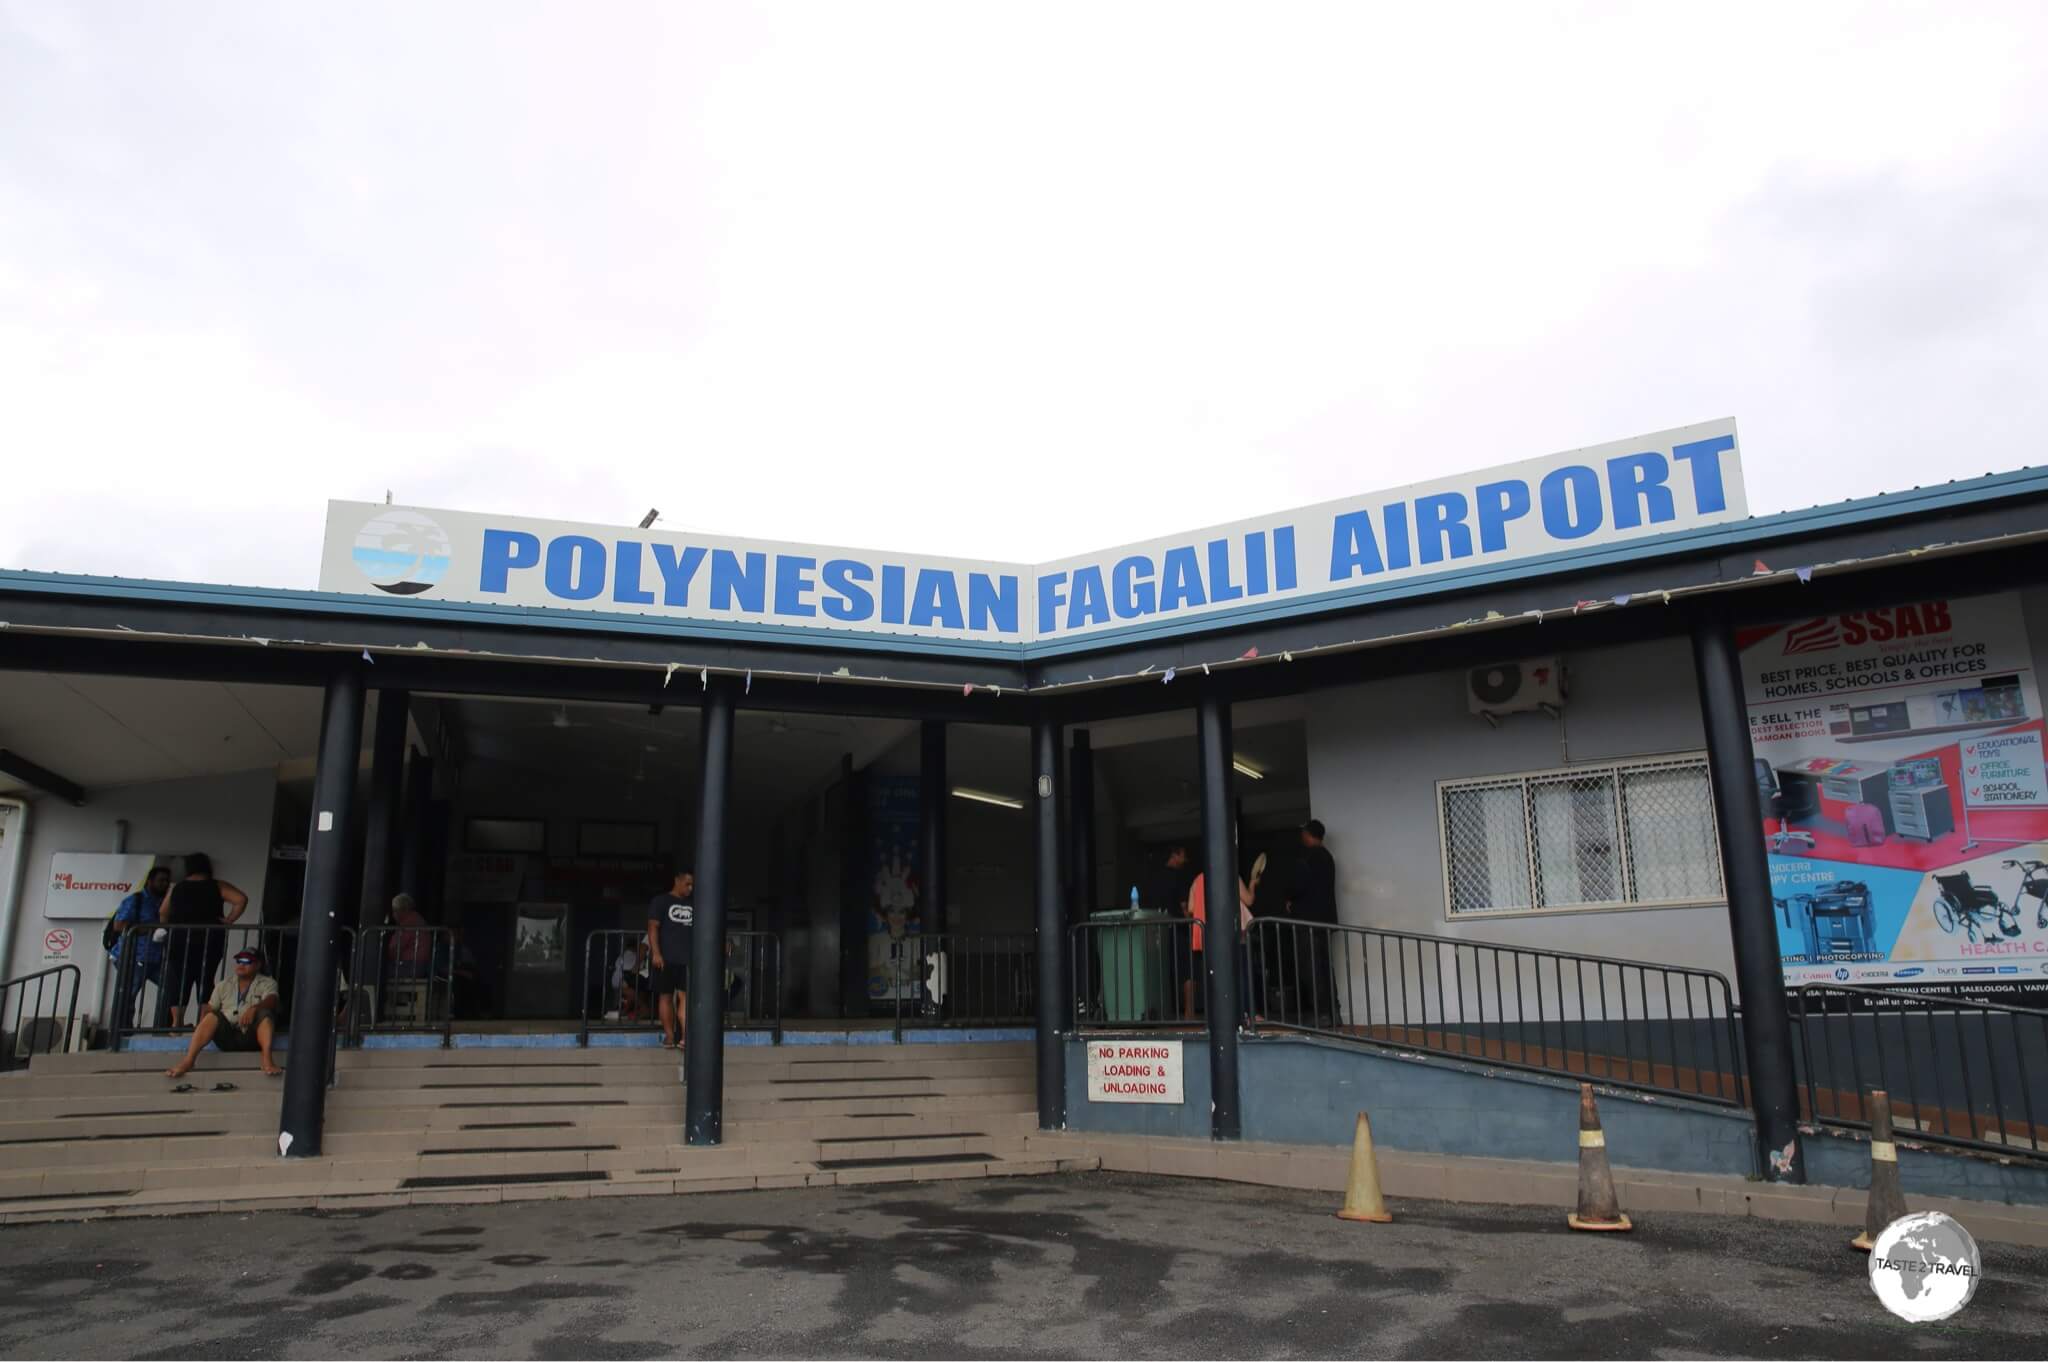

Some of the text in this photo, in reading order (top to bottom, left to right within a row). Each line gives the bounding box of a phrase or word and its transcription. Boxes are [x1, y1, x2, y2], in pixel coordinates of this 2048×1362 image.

[1038, 434, 1735, 633] FAGALII AIRPORT
[480, 527, 1018, 633] POLYNESIAN
[1840, 600, 1952, 645] SSAB
[1761, 643, 1986, 684] BEST PRICE, BEST QUALITY FOR
[1765, 659, 1987, 698] HOMES, SCHOOLS & OFFICES
[1761, 713, 1792, 725] SELL
[1795, 708, 1822, 721] THE
[1775, 720, 1823, 731] SELECTION
[1977, 735, 2039, 750] EDUCATIONAL
[1978, 749, 2000, 759] TOYS
[1981, 768, 2032, 780] FURNITURE
[1983, 783, 2020, 793] SCHOOL
[1984, 790, 2039, 803] STATIONERY
[1792, 871, 1835, 884] CENTRE
[1960, 941, 2048, 955] HEALTH C
[1816, 952, 1885, 963] PHOTOCOPYING
[1920, 985, 1952, 995] CENTRE
[1099, 1047, 1169, 1059] NO PARKING
[1104, 1065, 1165, 1077] LOADING &
[1103, 1082, 1166, 1095] UNLOADING
